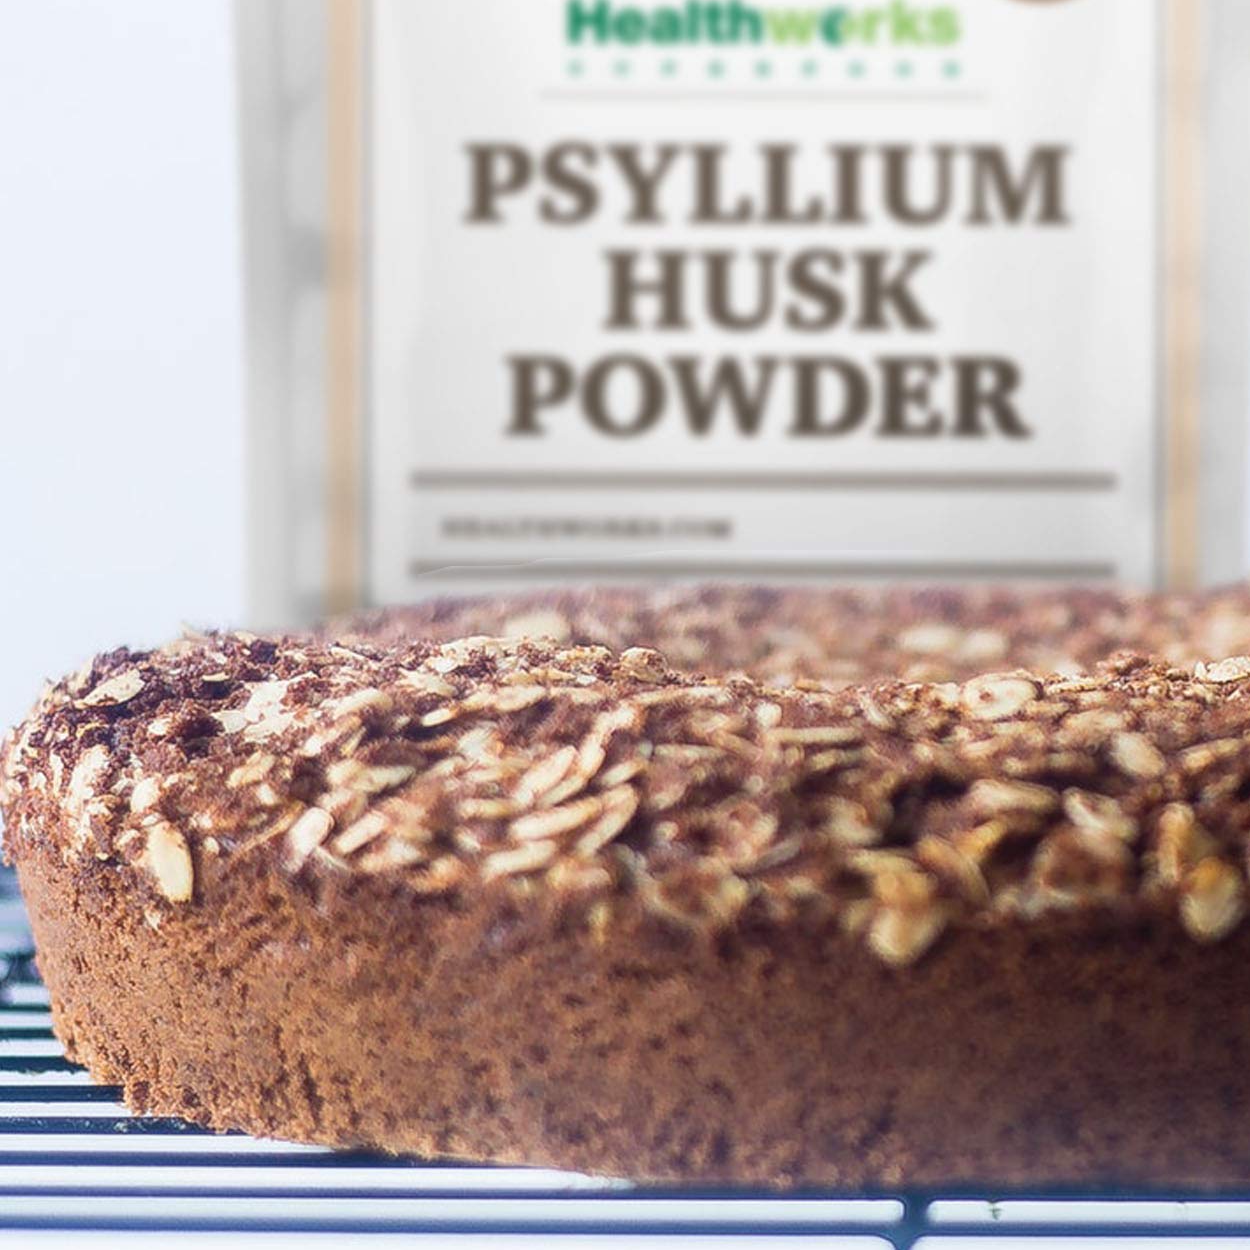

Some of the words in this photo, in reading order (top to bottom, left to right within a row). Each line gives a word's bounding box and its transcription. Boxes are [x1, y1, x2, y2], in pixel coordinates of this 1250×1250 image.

[463, 140, 1071, 228] PSYLLIUM
[602, 247, 935, 334] HUSK
[504, 352, 1035, 442] POWDER
